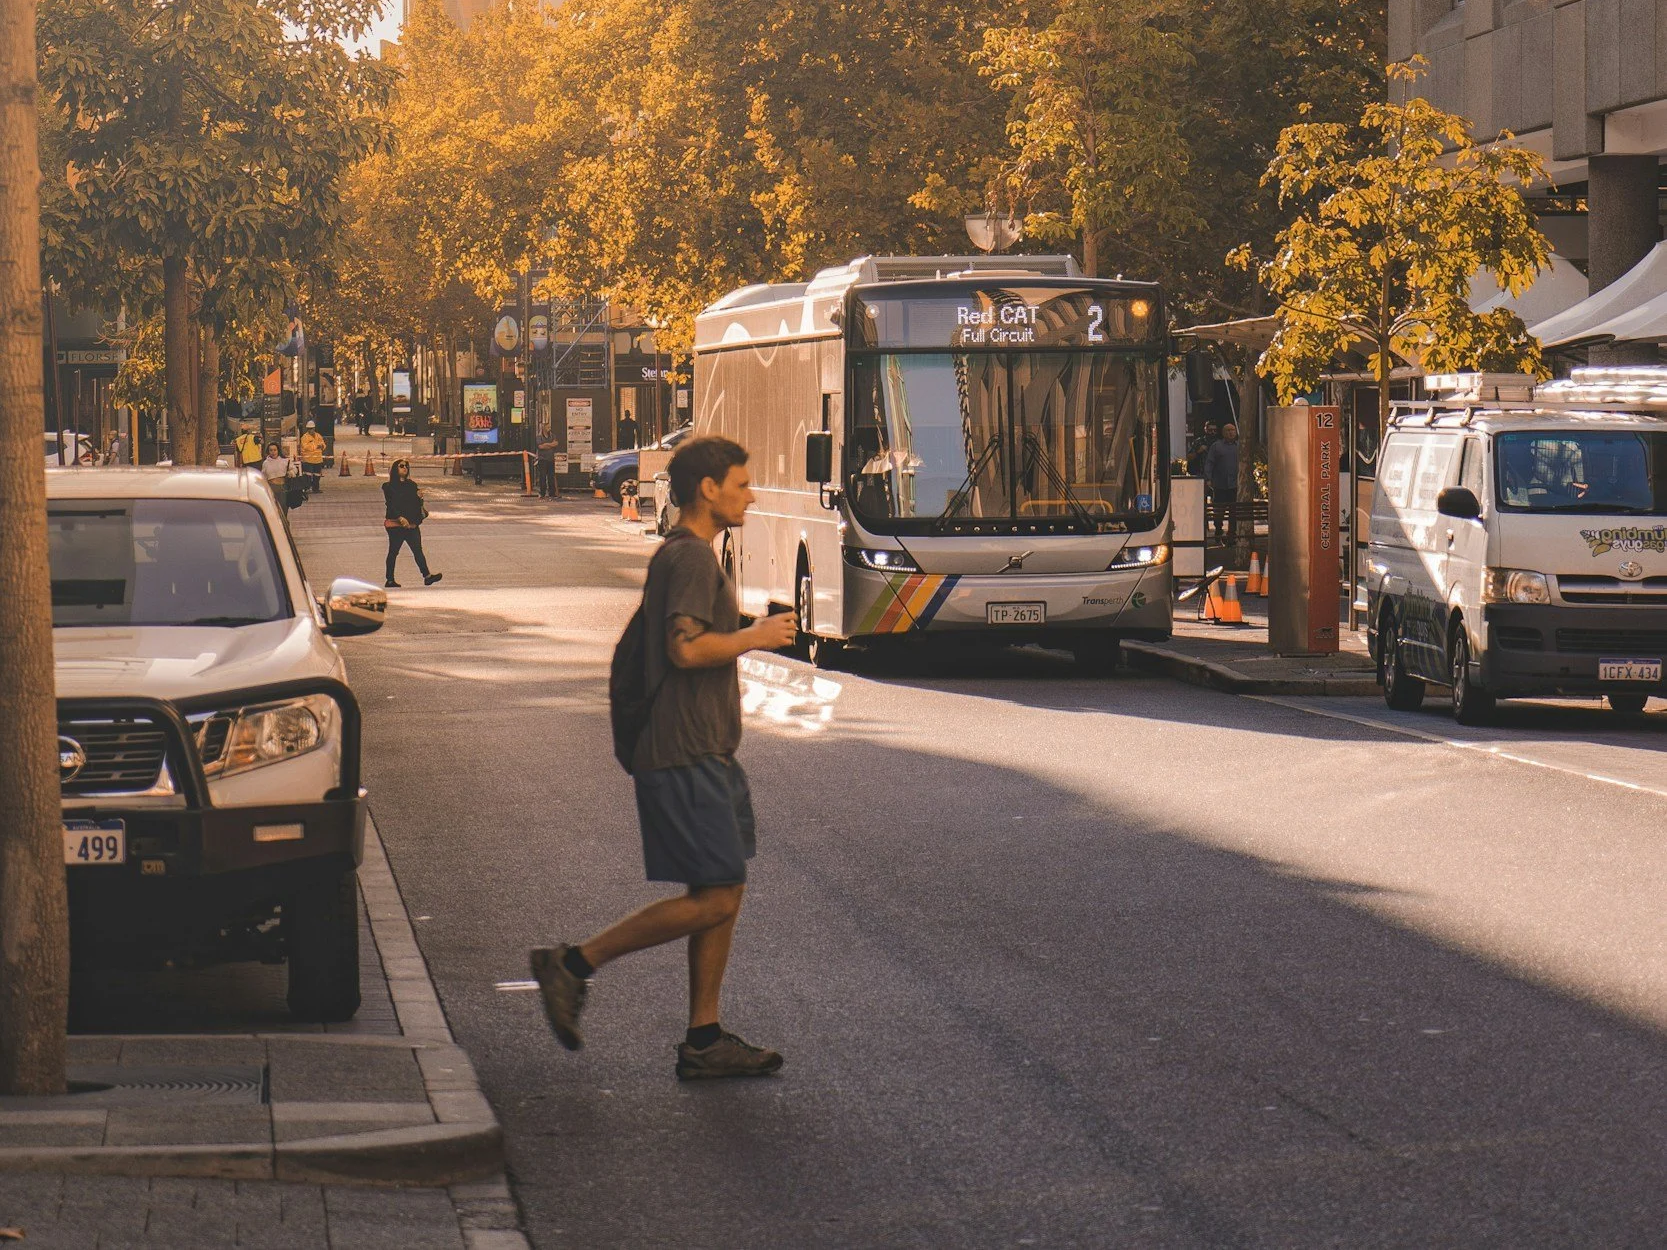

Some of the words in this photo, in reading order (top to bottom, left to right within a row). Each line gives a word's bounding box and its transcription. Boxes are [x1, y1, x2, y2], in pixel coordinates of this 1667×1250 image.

[957, 306, 993, 325] Red
[1000, 306, 1040, 325] CAT
[1087, 305, 1103, 342] 2
[962, 328, 986, 343] Full
[990, 328, 1035, 343] Circuit
[1316, 413, 1334, 429] 12
[1321, 440, 1331, 479] PARK
[1321, 483, 1331, 550] CENTRAL
[1082, 596, 1124, 606] Transperth
[994, 610, 1039, 621] TP-2675
